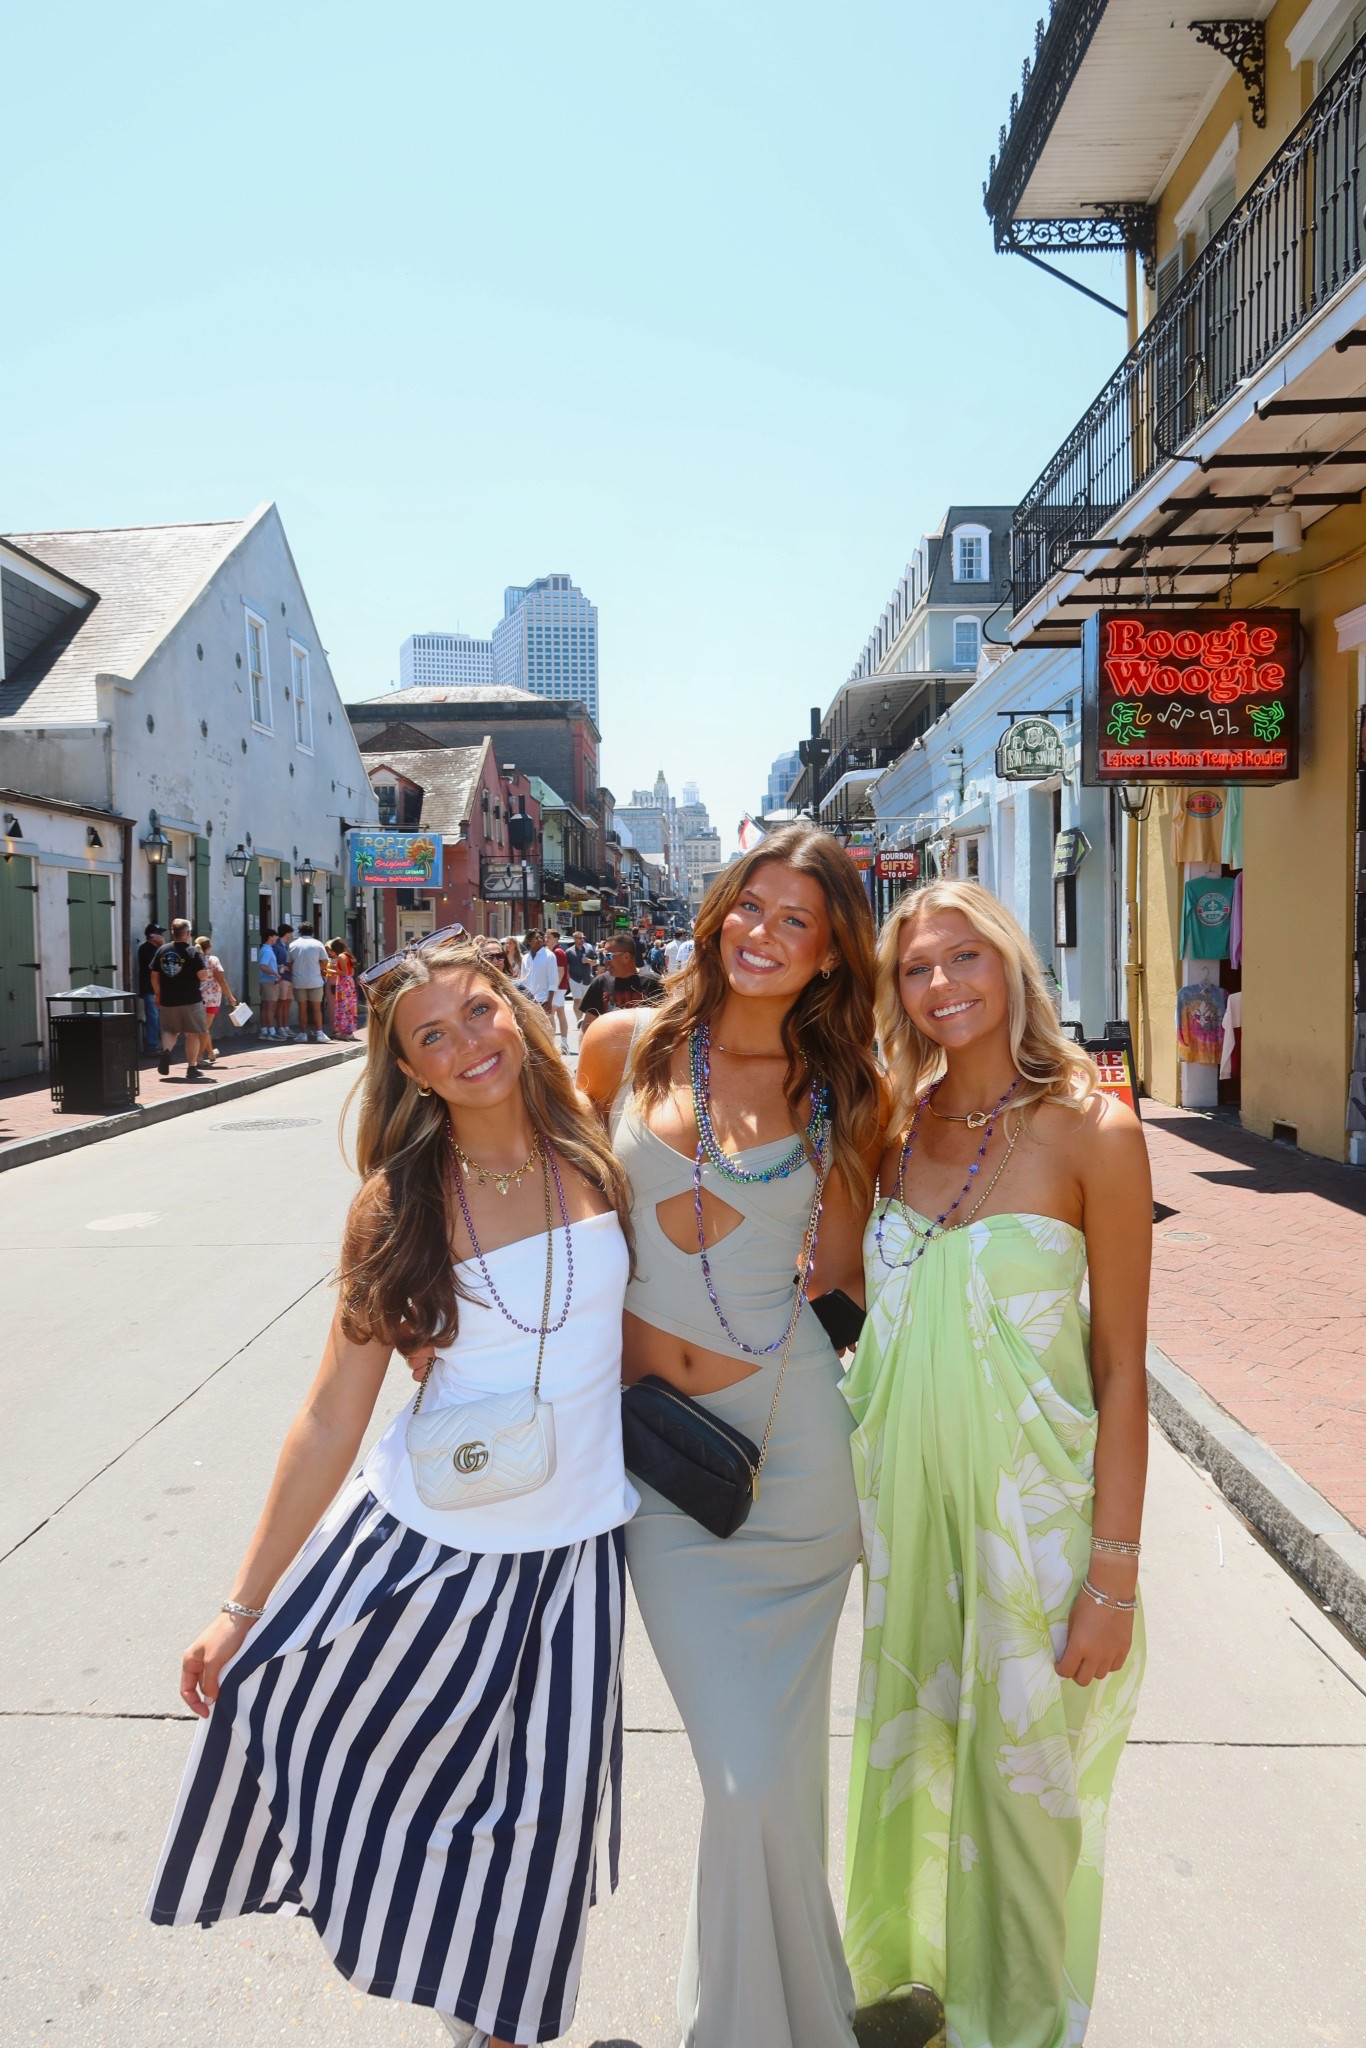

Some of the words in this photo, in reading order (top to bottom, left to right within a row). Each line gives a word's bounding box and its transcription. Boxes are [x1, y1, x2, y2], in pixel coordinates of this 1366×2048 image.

[1106, 620, 1278, 668] Boogie
[1104, 657, 1286, 704] Woogie
[1035, 748, 1062, 767] SWINE
[1149, 750, 1170, 767] Les
[1170, 750, 1200, 767] Bons
[1201, 750, 1243, 770] Temps
[356, 836, 435, 848] TROPICAL
[375, 848, 413, 859] ISLE
[881, 852, 914, 860] BOURBON
[374, 859, 412, 868] Original
[881, 860, 914, 871] GIFTS
